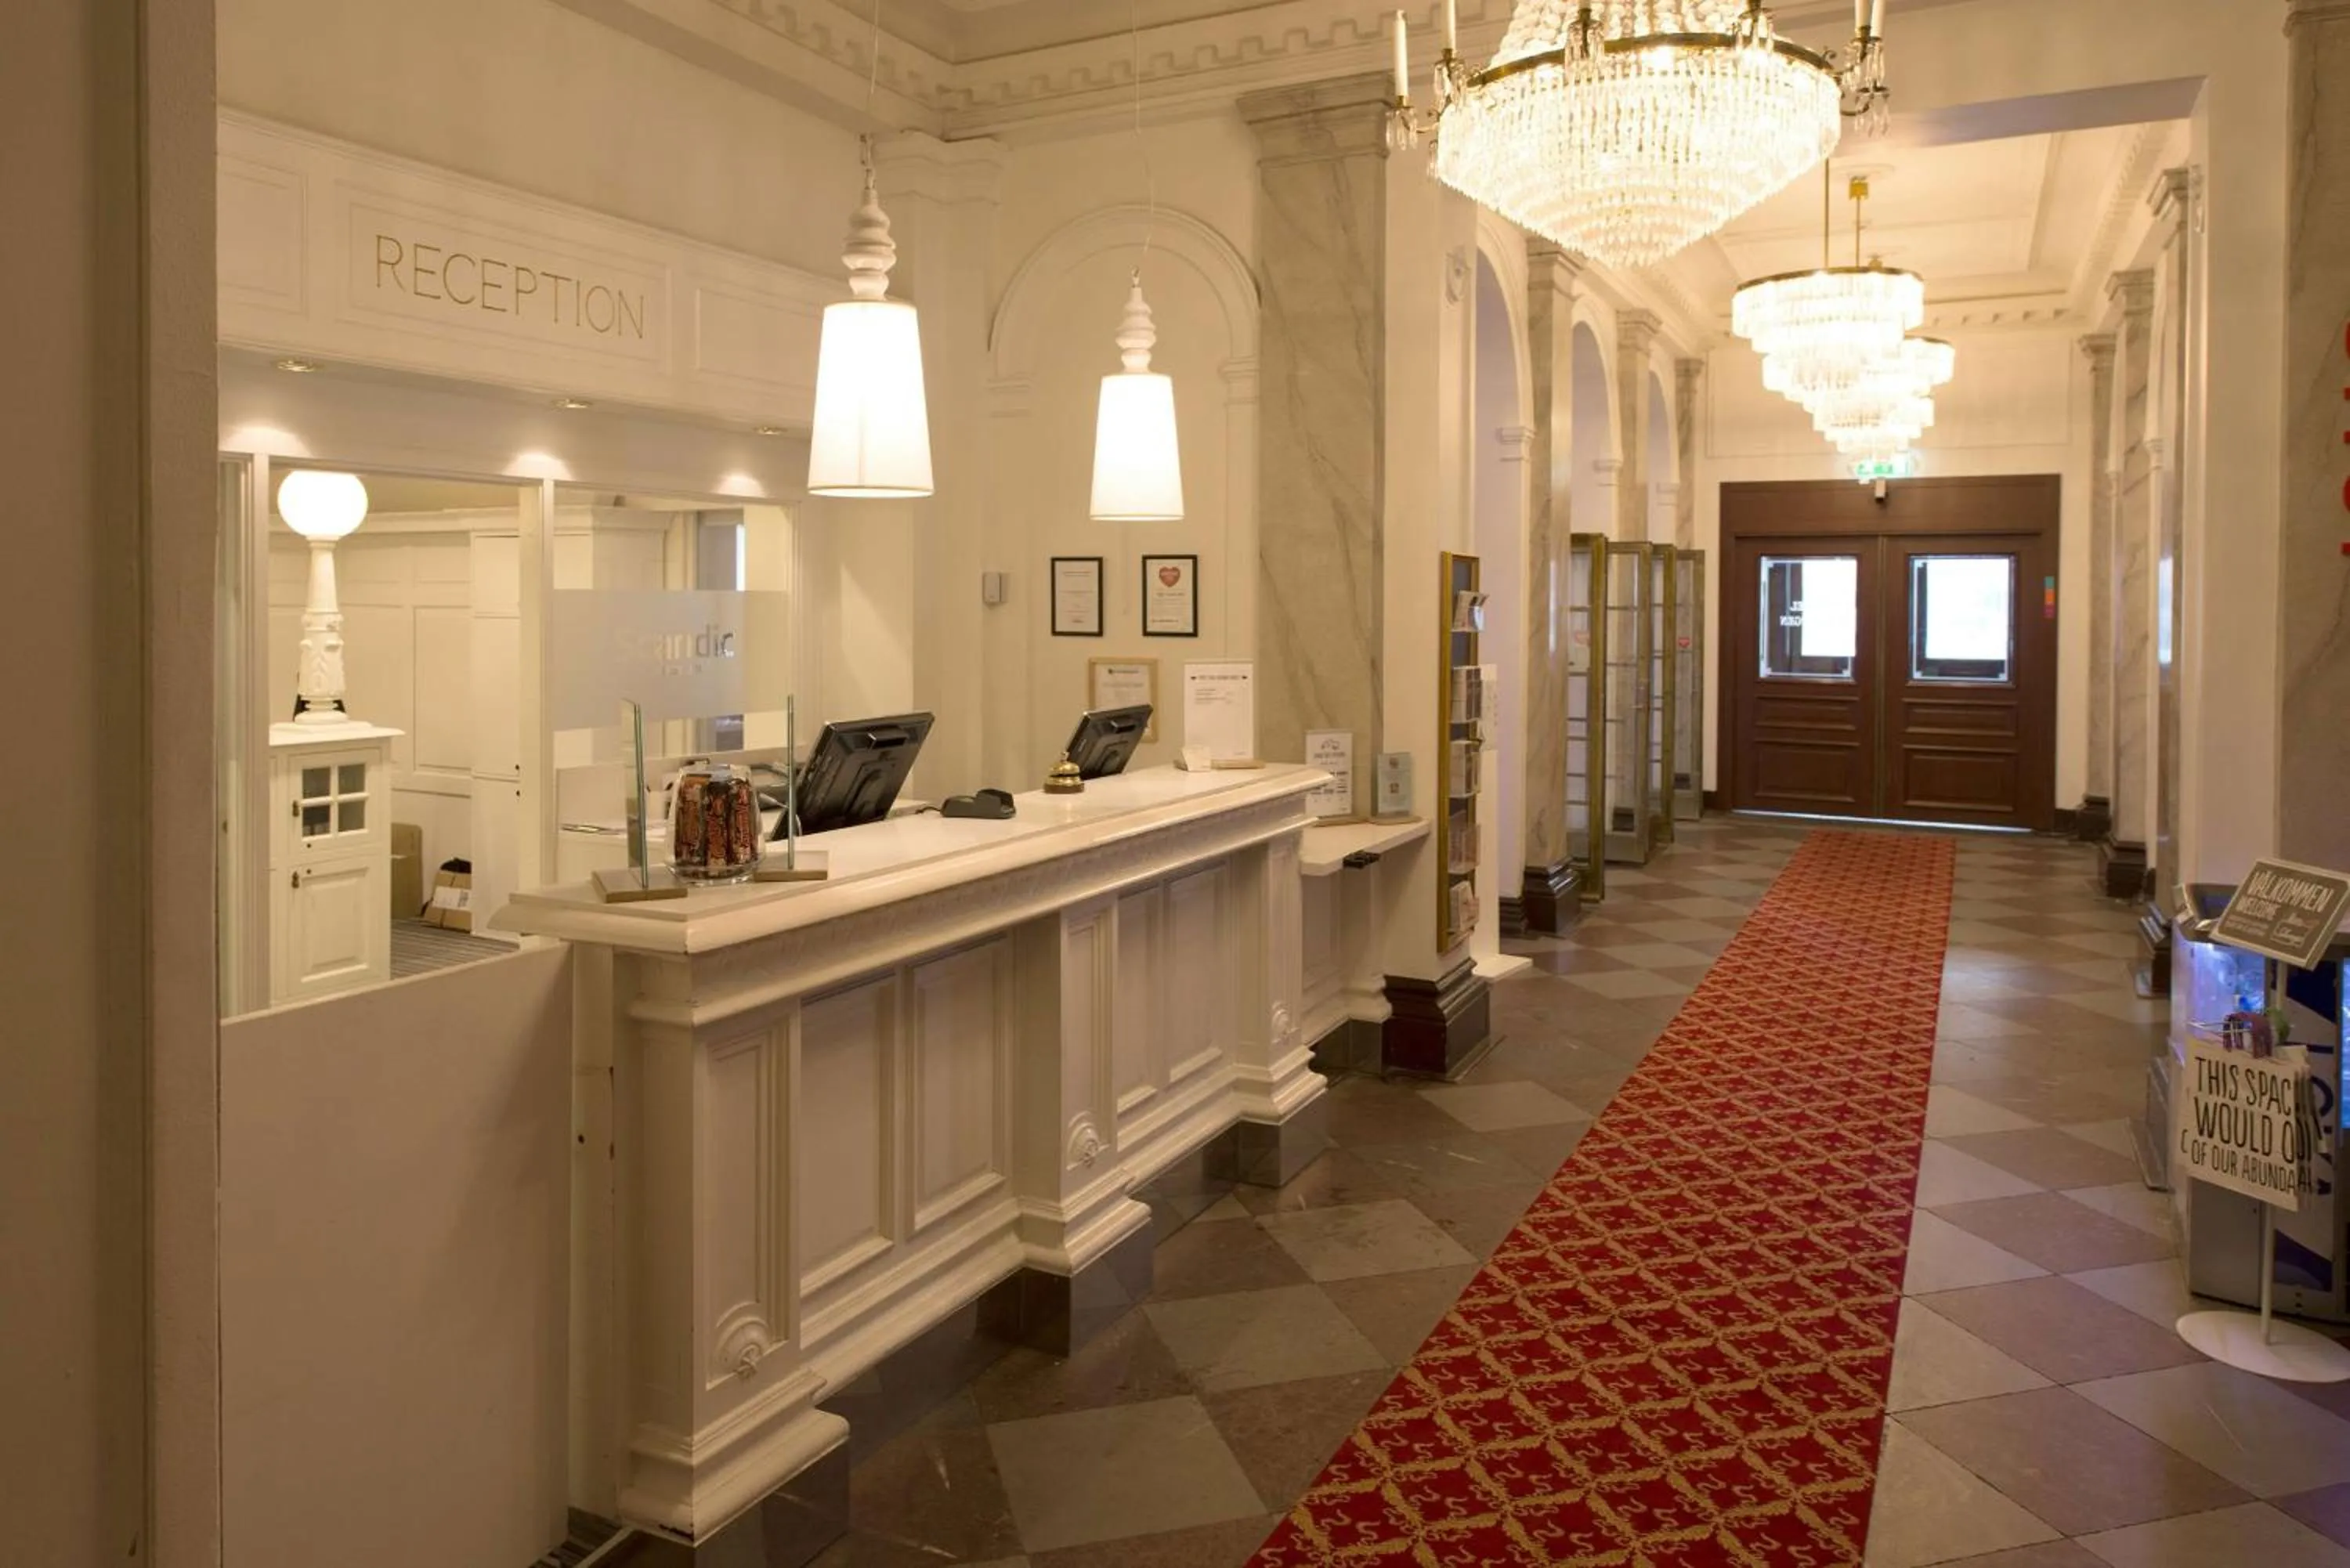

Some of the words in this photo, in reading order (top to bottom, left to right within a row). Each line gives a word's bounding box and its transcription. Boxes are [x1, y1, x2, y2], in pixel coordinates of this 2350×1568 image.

[375, 234, 644, 339] RECEPTION
[2193, 1056, 2240, 1102] THIS
[2193, 1097, 2273, 1158] WOULD
[2191, 1139, 2207, 1166] OF
[2211, 1144, 2237, 1178] OUR
